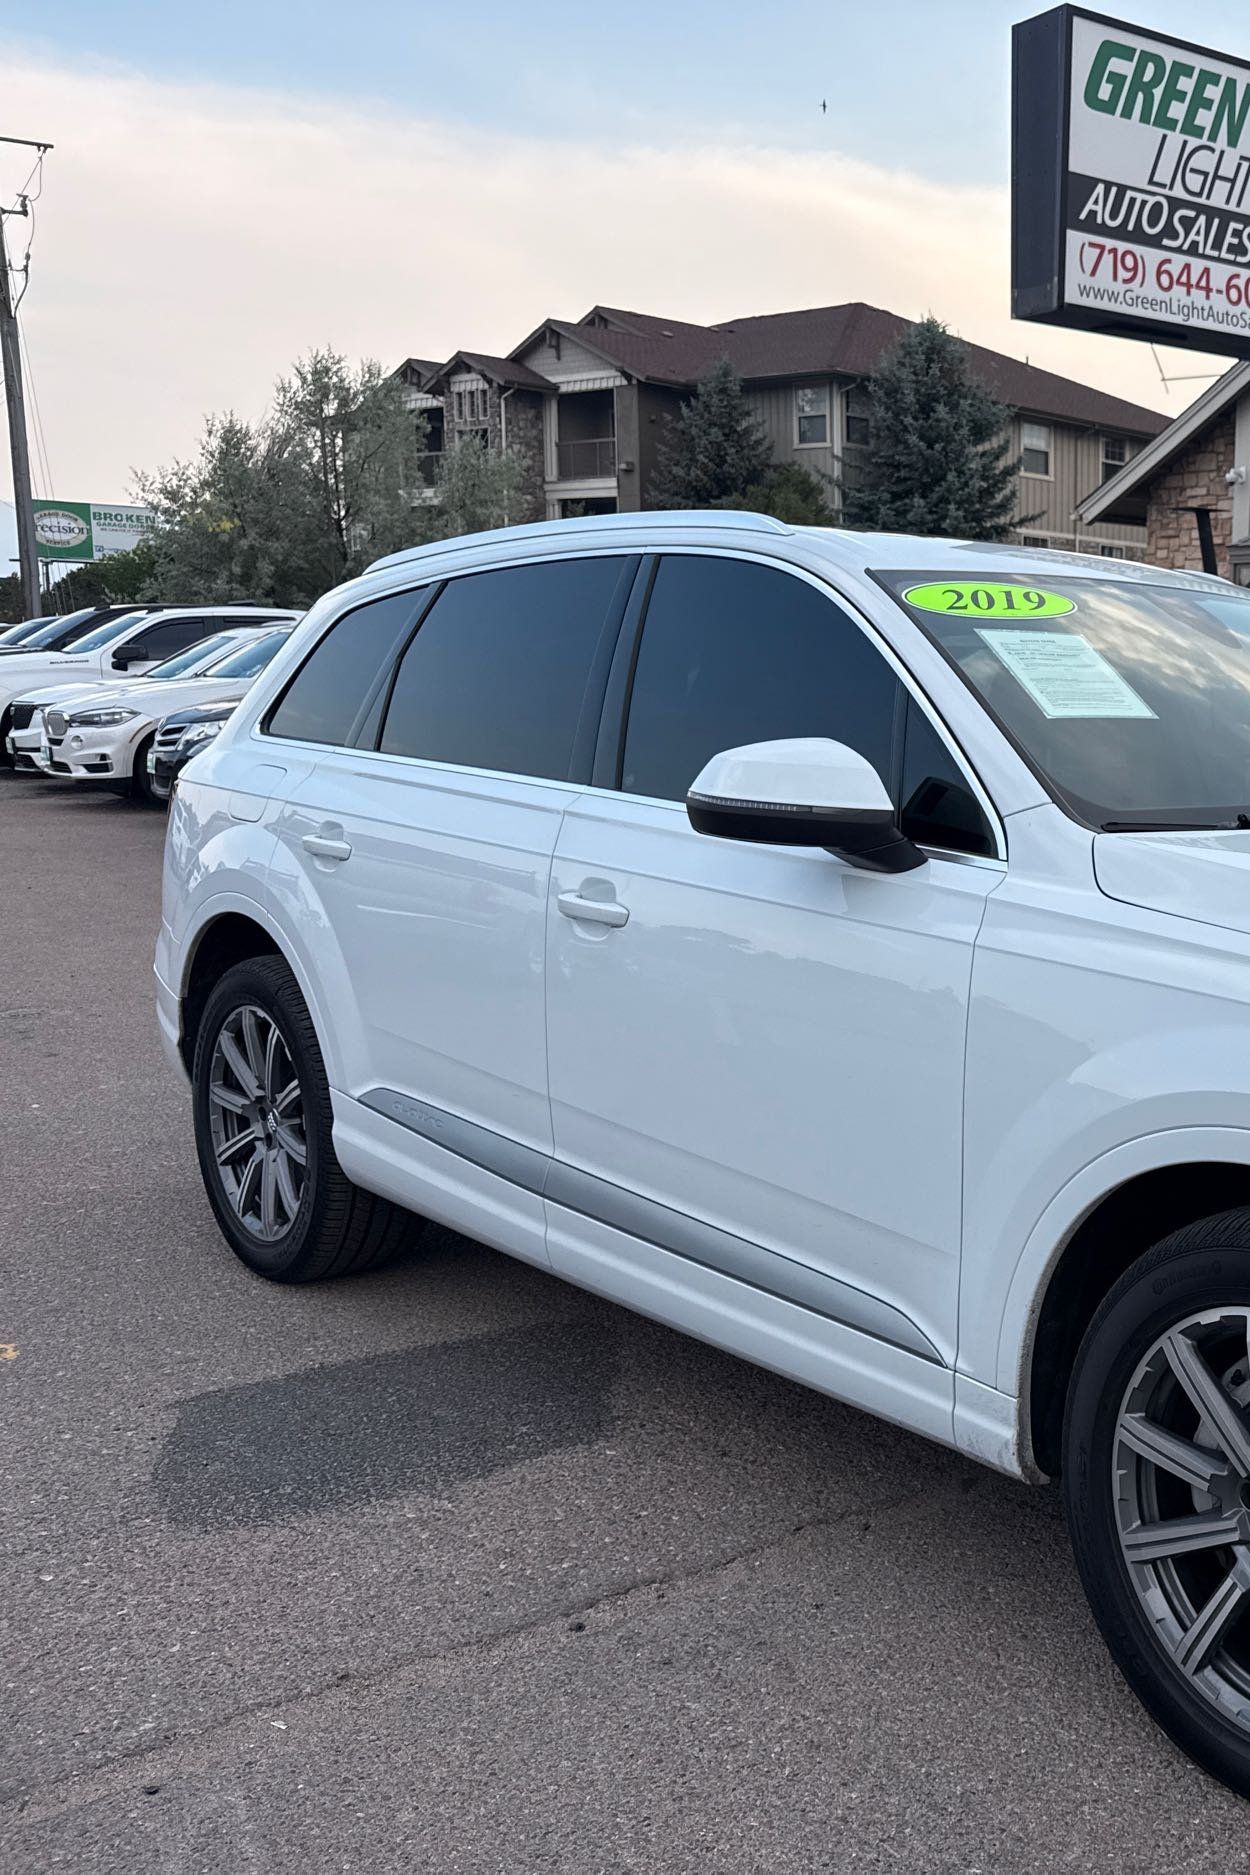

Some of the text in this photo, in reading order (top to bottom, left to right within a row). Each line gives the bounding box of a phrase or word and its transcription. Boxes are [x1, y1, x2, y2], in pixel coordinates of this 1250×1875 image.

[1079, 183, 1169, 235] AUTO
[1079, 241, 1146, 288] (719)
[92, 511, 156, 524] BROKEN
[96, 521, 127, 529] GARAGE
[34, 521, 88, 535] recision
[942, 588, 1047, 611] 2019
